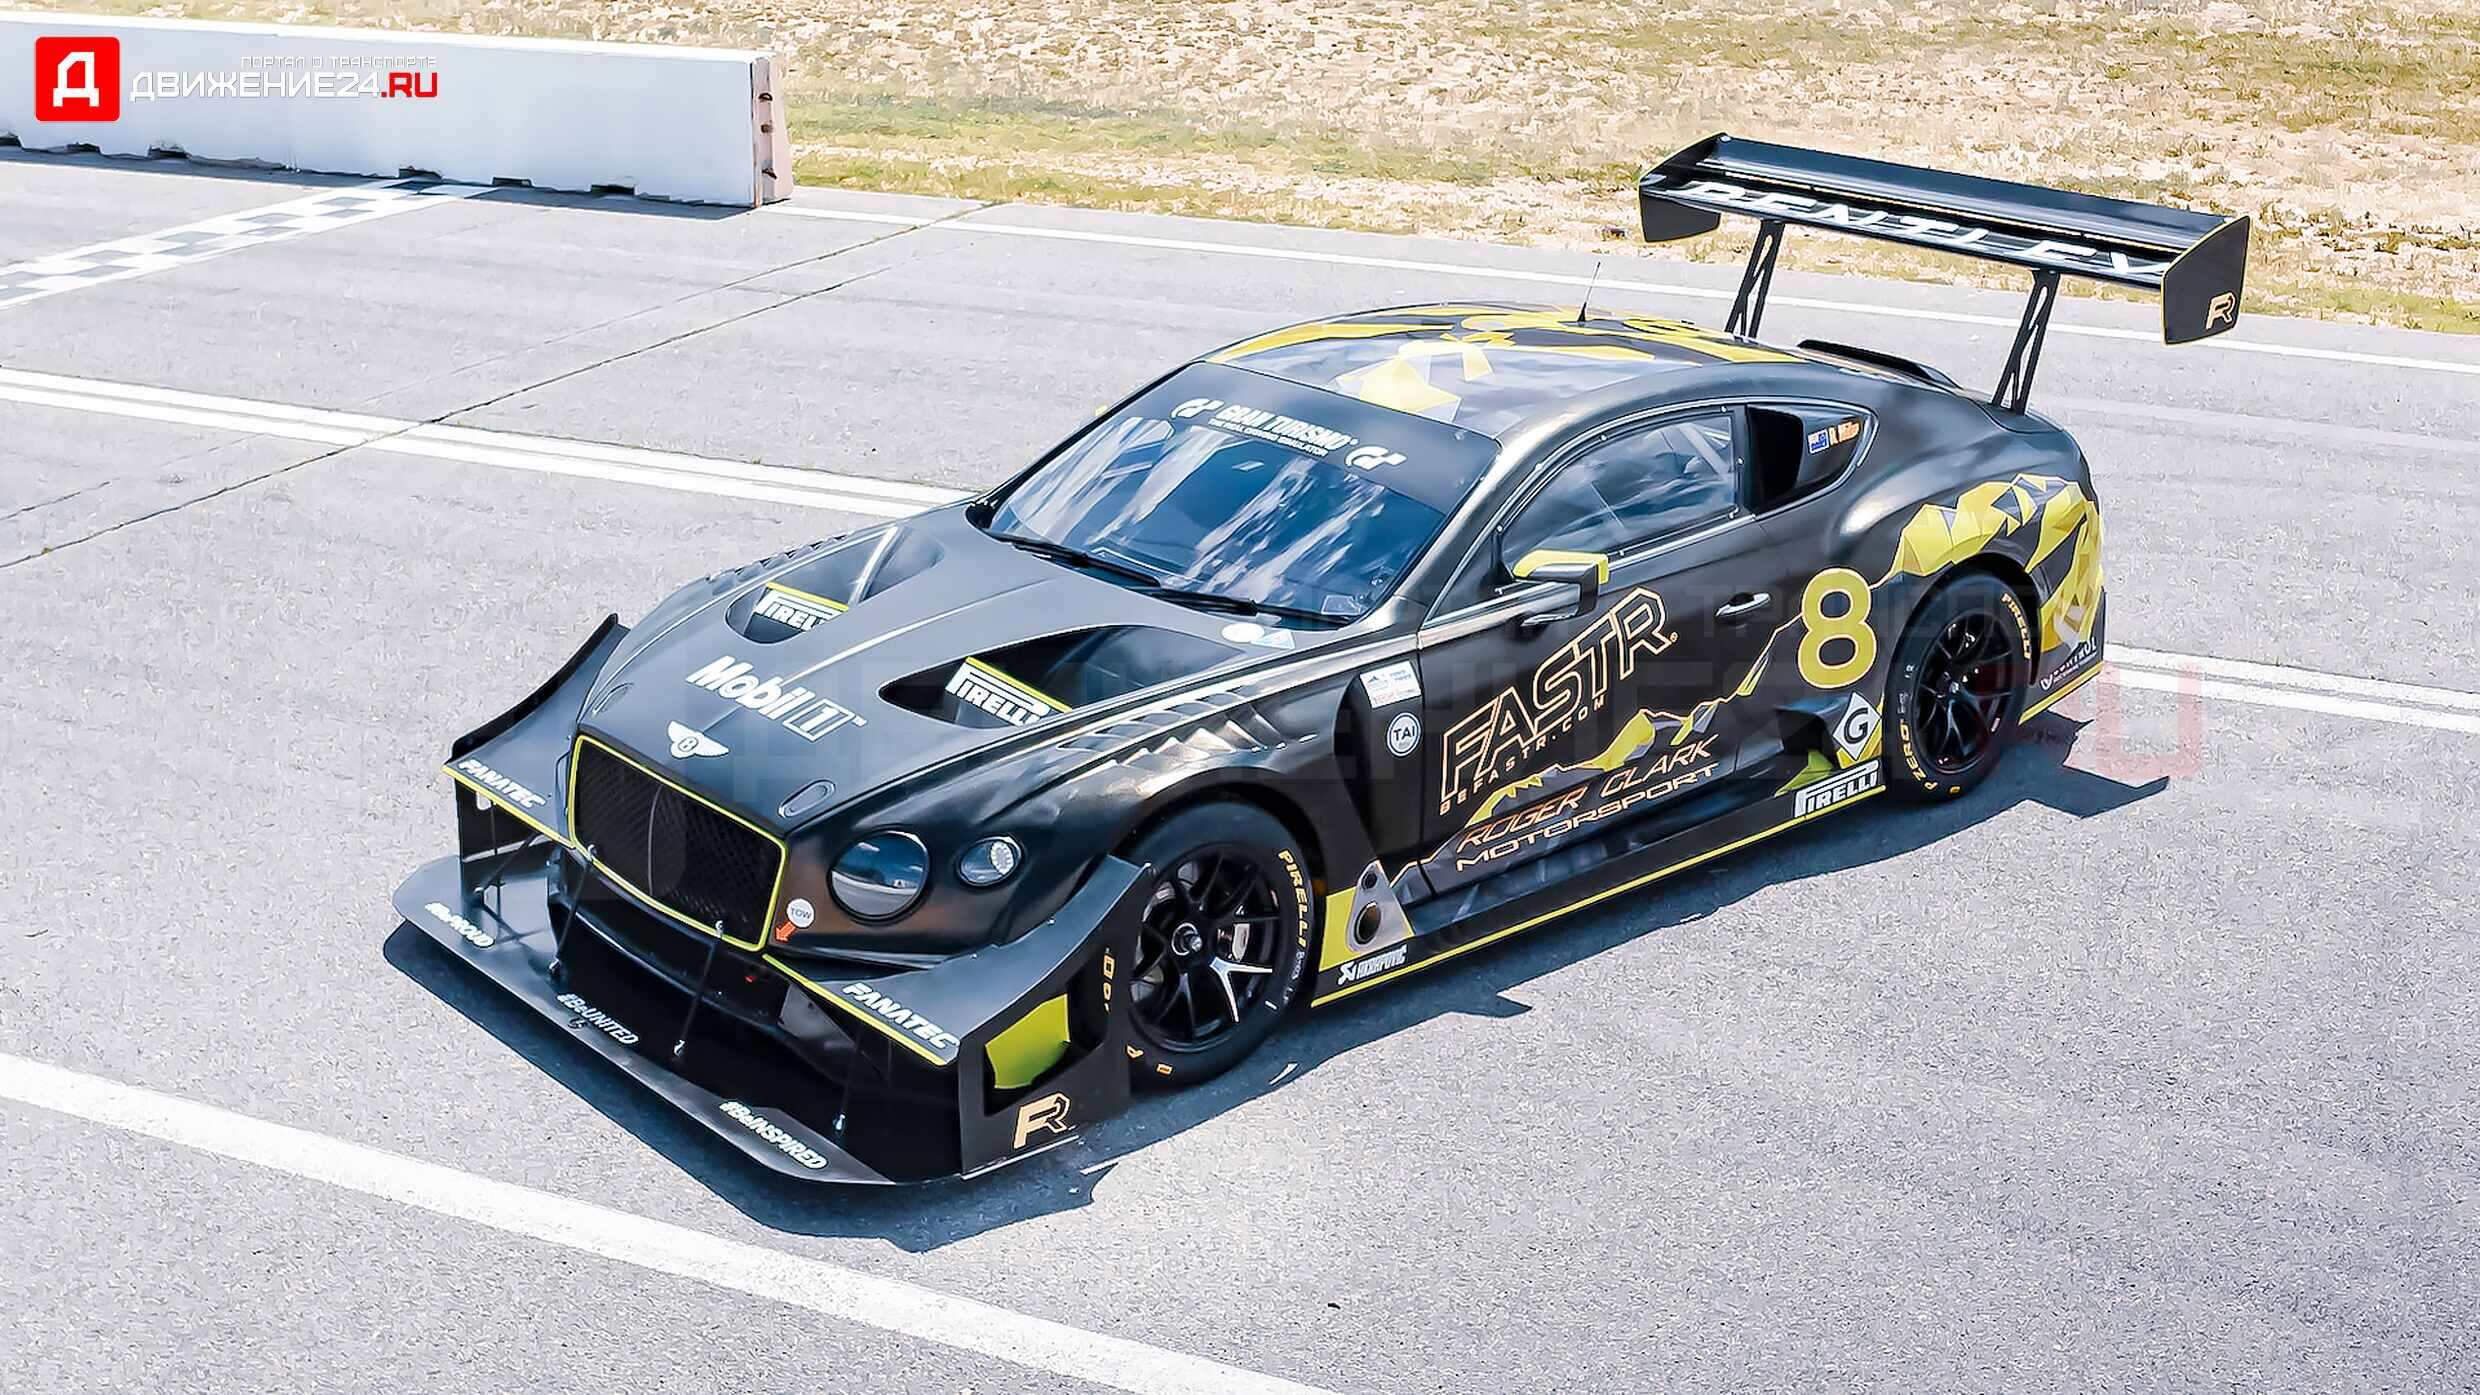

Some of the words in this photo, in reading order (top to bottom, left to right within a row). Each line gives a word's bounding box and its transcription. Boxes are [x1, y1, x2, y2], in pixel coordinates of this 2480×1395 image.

[1215, 404, 1275, 431] GRAN
[1264, 414, 1352, 451] TURISMO
[753, 589, 844, 632] PIREL
[1797, 566, 1878, 690] 8
[686, 655, 816, 721] Mobil
[1393, 725, 1415, 742] TAI
[1843, 707, 1869, 745] G
[457, 758, 547, 809] FANATEC
[1457, 786, 1588, 854] ROGER
[1600, 734, 1720, 799] CLARK
[1794, 759, 1880, 819] PIRELLI
[1456, 762, 1720, 873] MOTORSPORT
[556, 992, 640, 1046] #BeUNITED
[841, 981, 961, 1050] FANATEC
[718, 1099, 828, 1170] #BeINSPIRED
